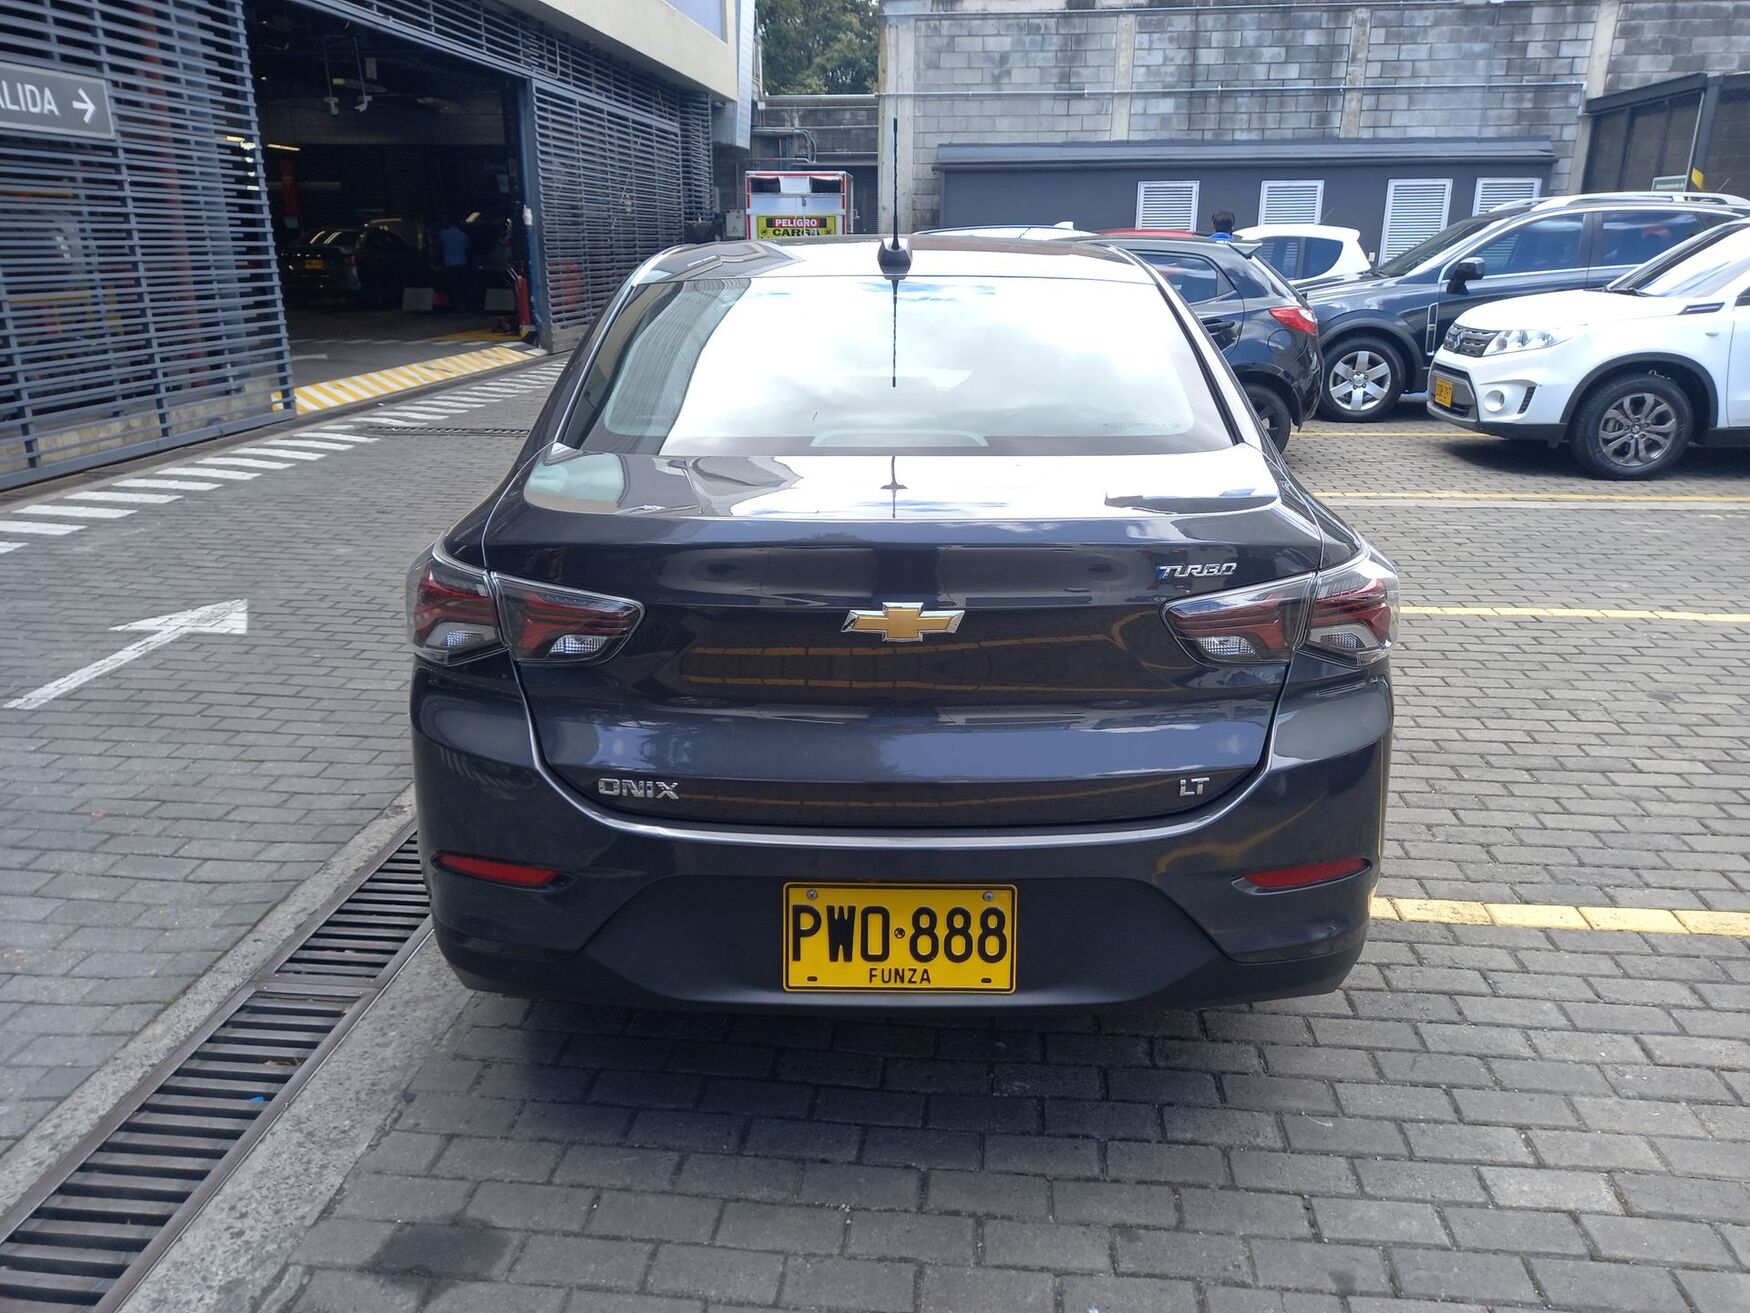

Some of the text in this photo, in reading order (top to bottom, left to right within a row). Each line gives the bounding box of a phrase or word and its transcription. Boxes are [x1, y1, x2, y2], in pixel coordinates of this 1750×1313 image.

[775, 218, 817, 227] PELIGRO
[772, 228, 820, 237] CARGA
[1156, 562, 1237, 580] TURBO
[598, 778, 679, 800] ONIX
[1180, 777, 1210, 796] LT
[868, 967, 931, 984] FUNZA
